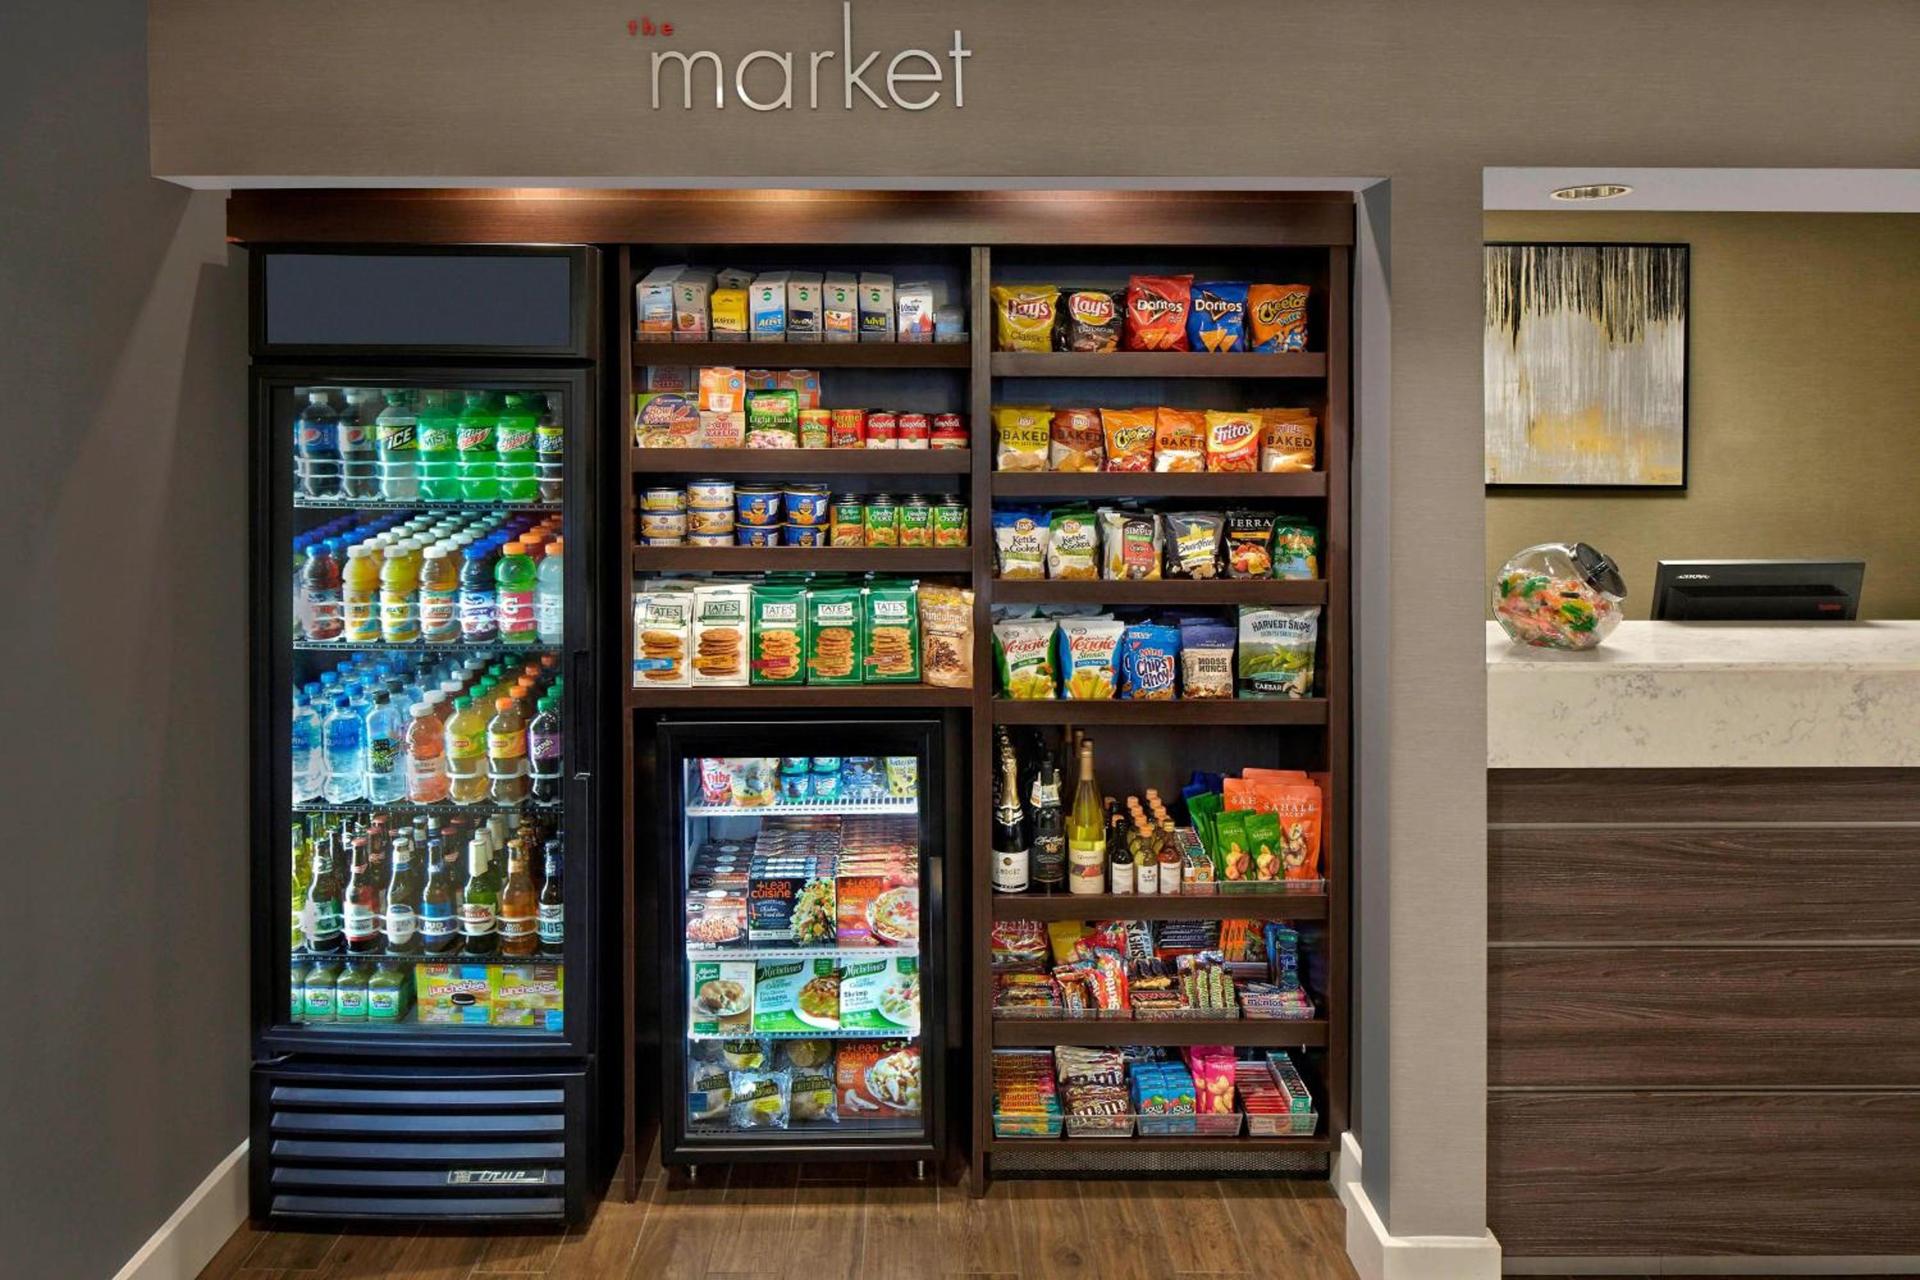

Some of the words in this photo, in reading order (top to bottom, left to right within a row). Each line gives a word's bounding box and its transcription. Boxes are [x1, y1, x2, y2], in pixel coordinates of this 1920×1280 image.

[628, 17, 675, 37] the
[651, 1, 972, 111] market
[1137, 299, 1183, 313] Doritos
[1195, 299, 1242, 312] Doritos
[386, 425, 414, 450] ICE
[1002, 429, 1048, 441] BAKED
[1058, 430, 1101, 441] BAKED
[1213, 423, 1252, 442] Fritos
[1161, 436, 1205, 447] BAKED
[1267, 435, 1313, 447] BAKED
[1229, 518, 1272, 528] TERRA
[1012, 535, 1037, 544] Kettle
[1009, 543, 1040, 552] Cooked
[1251, 620, 1288, 632] HARVEST
[1002, 637, 1049, 653] Veggie
[1069, 636, 1116, 651] Veggie
[1136, 656, 1167, 675] Chips
[1198, 657, 1228, 665] MOOSE
[1198, 665, 1228, 673] MUNCH
[1255, 682, 1282, 691] CAESAR
[1263, 802, 1315, 812] SAHALE
[764, 880, 791, 890] Lean
[750, 888, 791, 899] cuisine
[1247, 999, 1285, 1008] mentos
